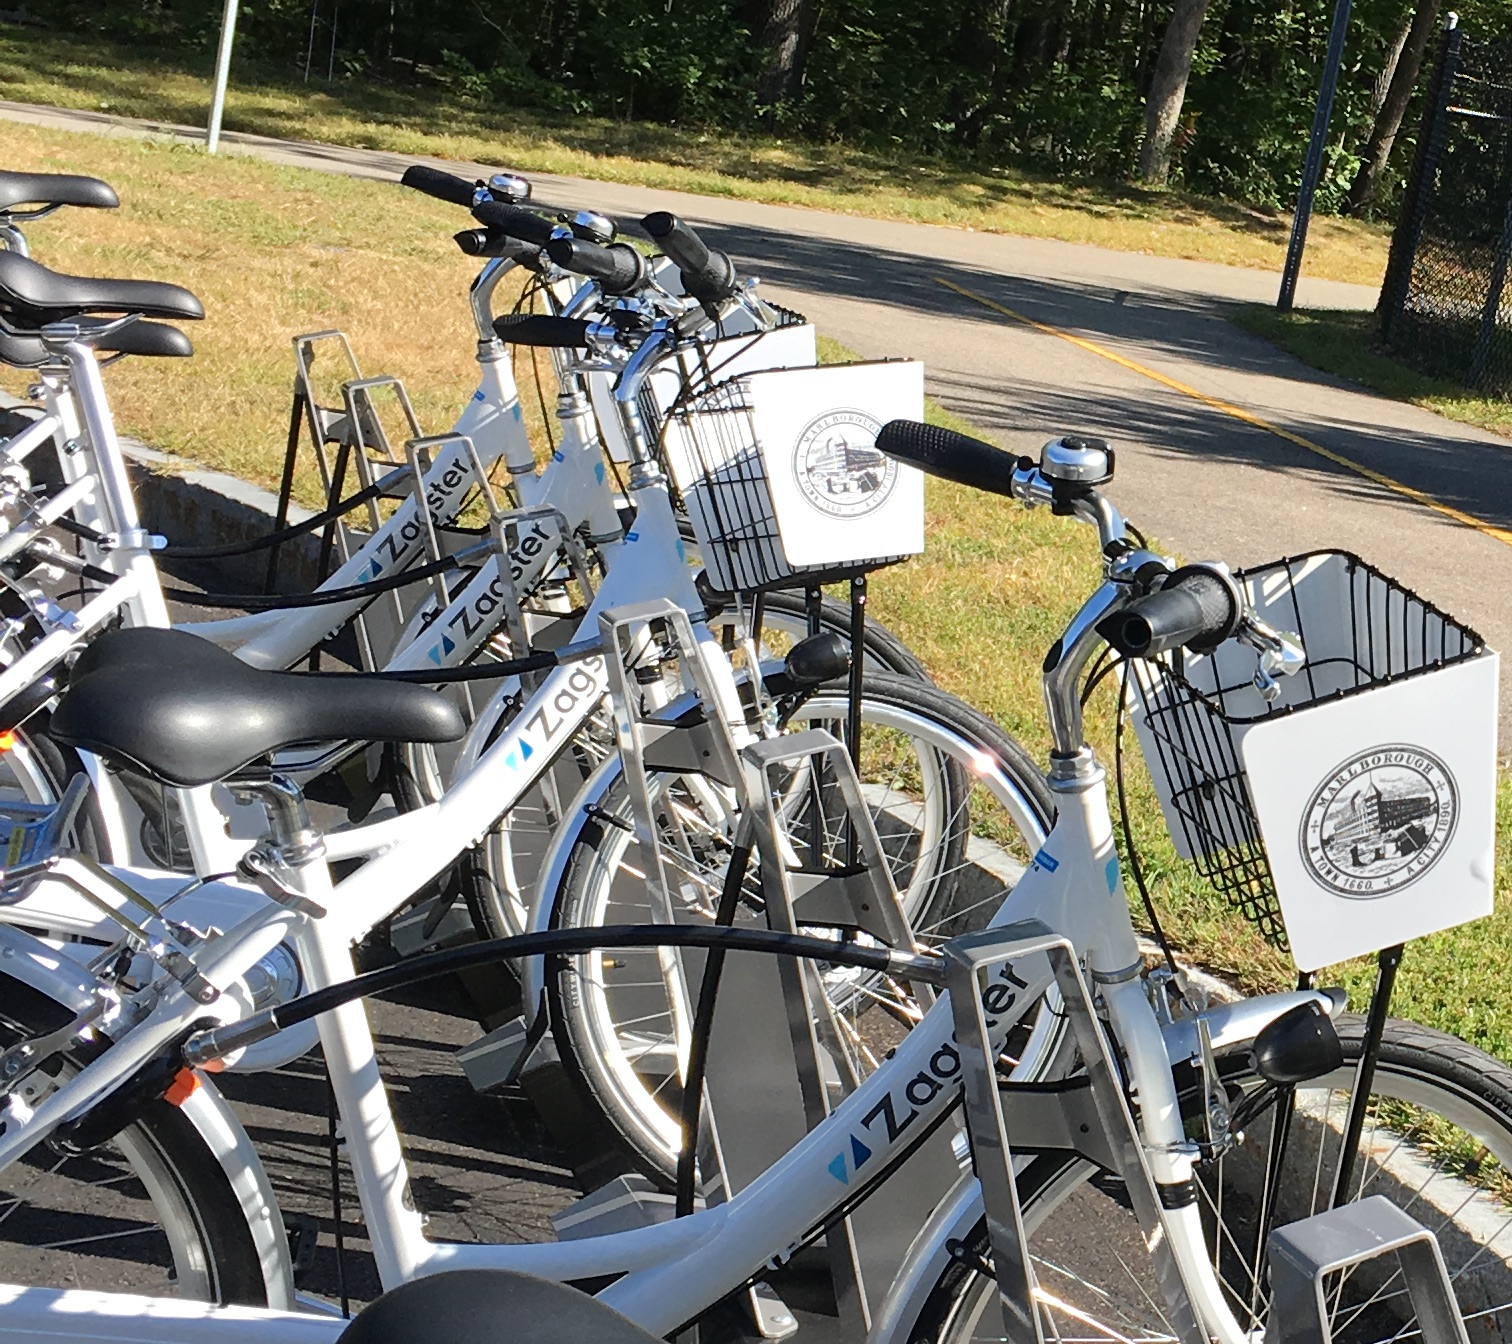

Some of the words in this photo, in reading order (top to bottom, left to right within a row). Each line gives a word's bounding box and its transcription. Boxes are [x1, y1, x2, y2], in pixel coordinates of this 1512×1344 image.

[524, 656, 604, 742] Zags
[1317, 753, 1435, 809] MARLBOROUGH
[1314, 856, 1341, 883] TOWN
[1417, 835, 1443, 866] CITY
[860, 961, 1029, 1145] Zager
